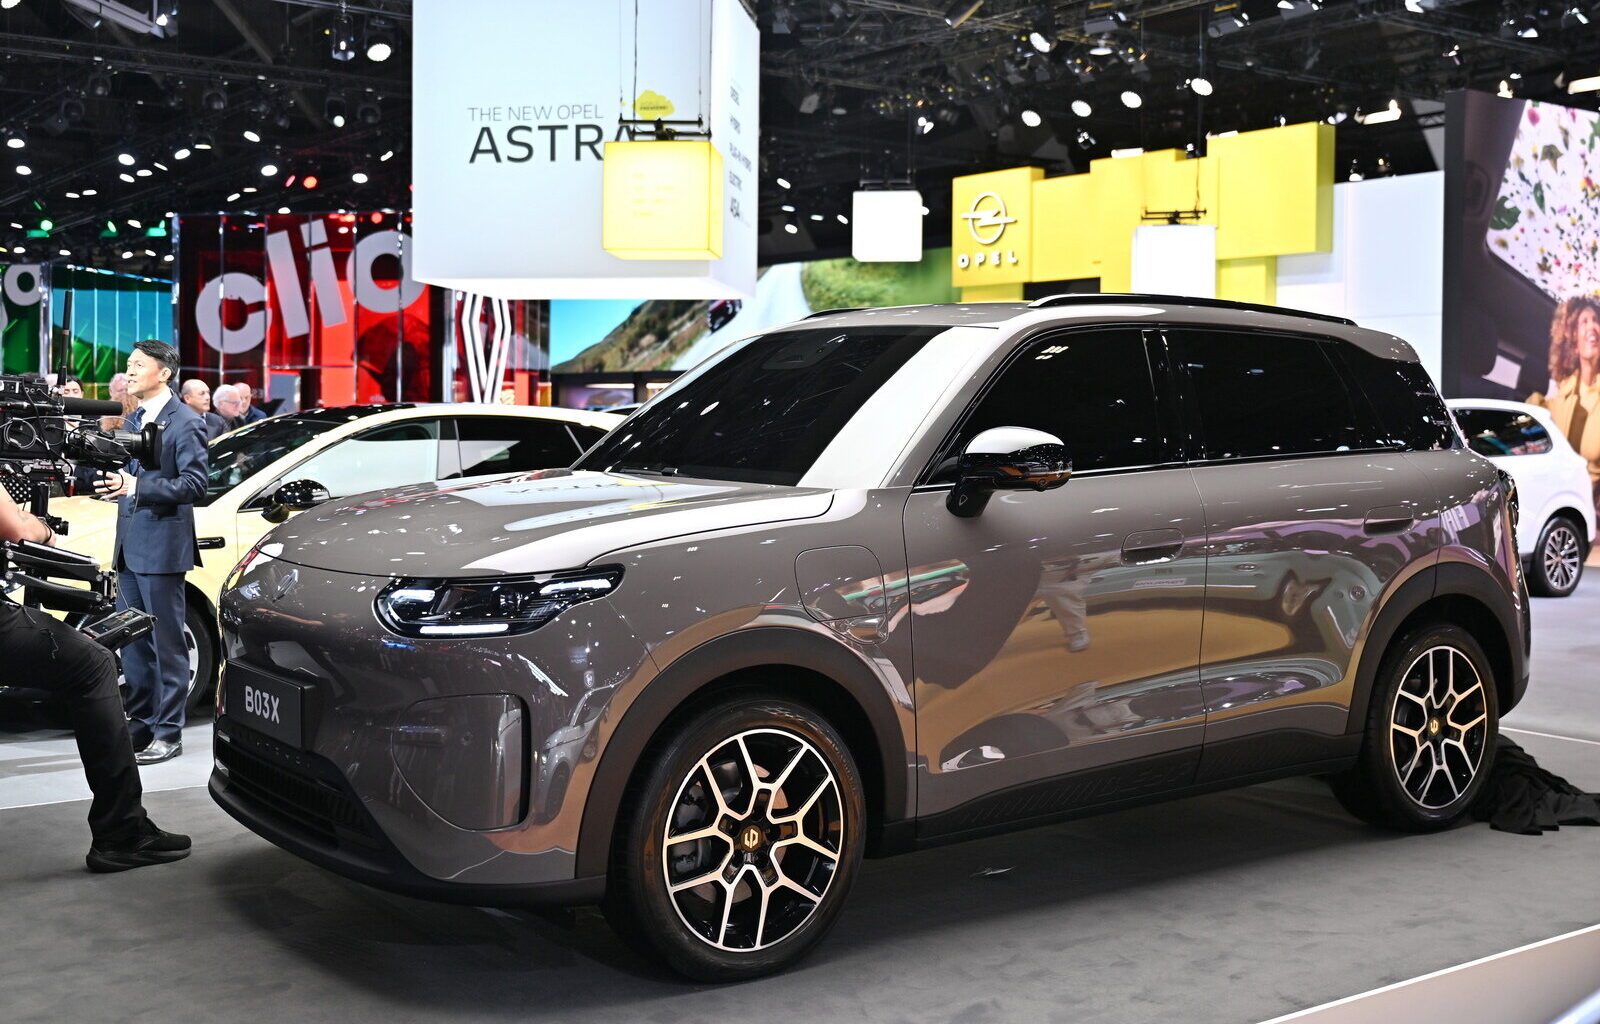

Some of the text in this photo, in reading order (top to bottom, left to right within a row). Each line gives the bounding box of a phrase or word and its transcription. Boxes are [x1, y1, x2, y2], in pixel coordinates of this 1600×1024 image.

[468, 104, 604, 121] THE NEW OPEL
[957, 250, 1018, 270] OPEL
[195, 219, 426, 354] clio
[245, 685, 280, 724] B03X
